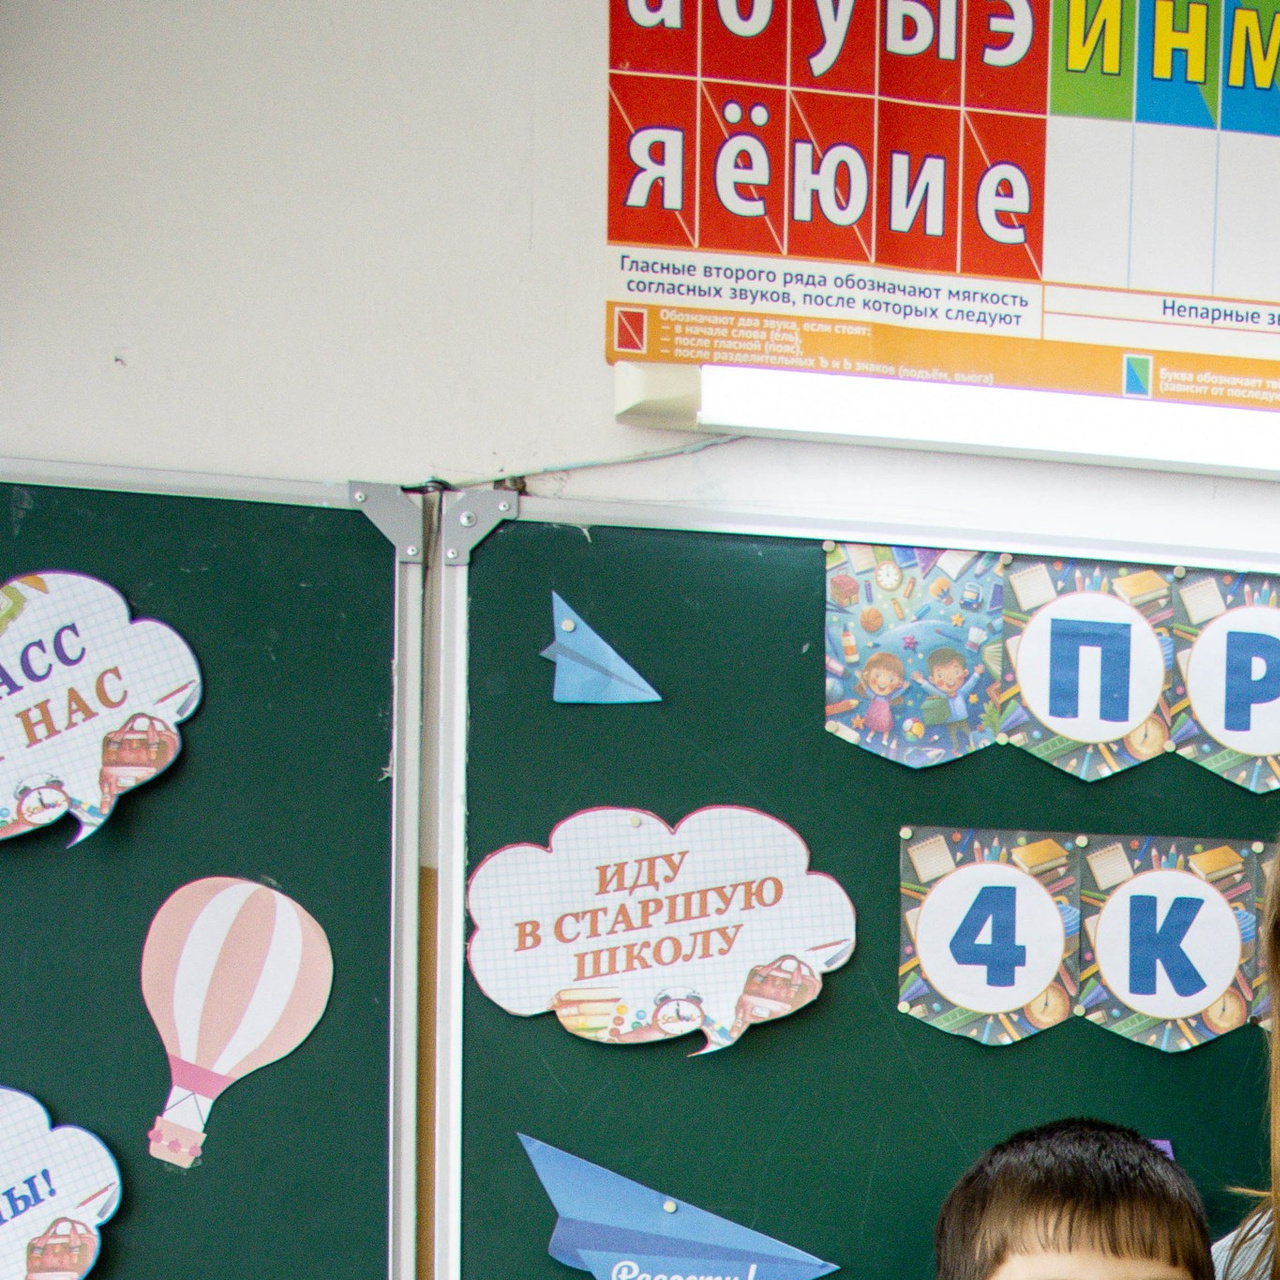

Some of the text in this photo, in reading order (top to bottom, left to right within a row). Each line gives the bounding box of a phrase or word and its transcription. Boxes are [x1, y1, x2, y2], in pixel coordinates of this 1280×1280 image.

[620, 255, 1029, 308] Гласные второго ряда обозначают мягкость
[627, 279, 1022, 327] согласных звуков, после которых следуют
[660, 308, 735, 326] Обозначают
[803, 322, 831, 333] если
[731, 327, 767, 340] слова
[1162, 299, 1261, 324] Непарные
[674, 348, 710, 360] после
[855, 362, 896, 375] знаков
[675, 336, 710, 347] после
[713, 338, 761, 351] гласной
[1159, 367, 1195, 384] Буква
[1210, 384, 1224, 396] от
[15, 666, 128, 748] НАС
[595, 850, 690, 896] ИДУ
[514, 876, 784, 952] В СТАРШУЮ
[948, 885, 1026, 988] 4
[573, 924, 744, 982] ШКОЛУ
[0, 1168, 57, 1226] Ы!
